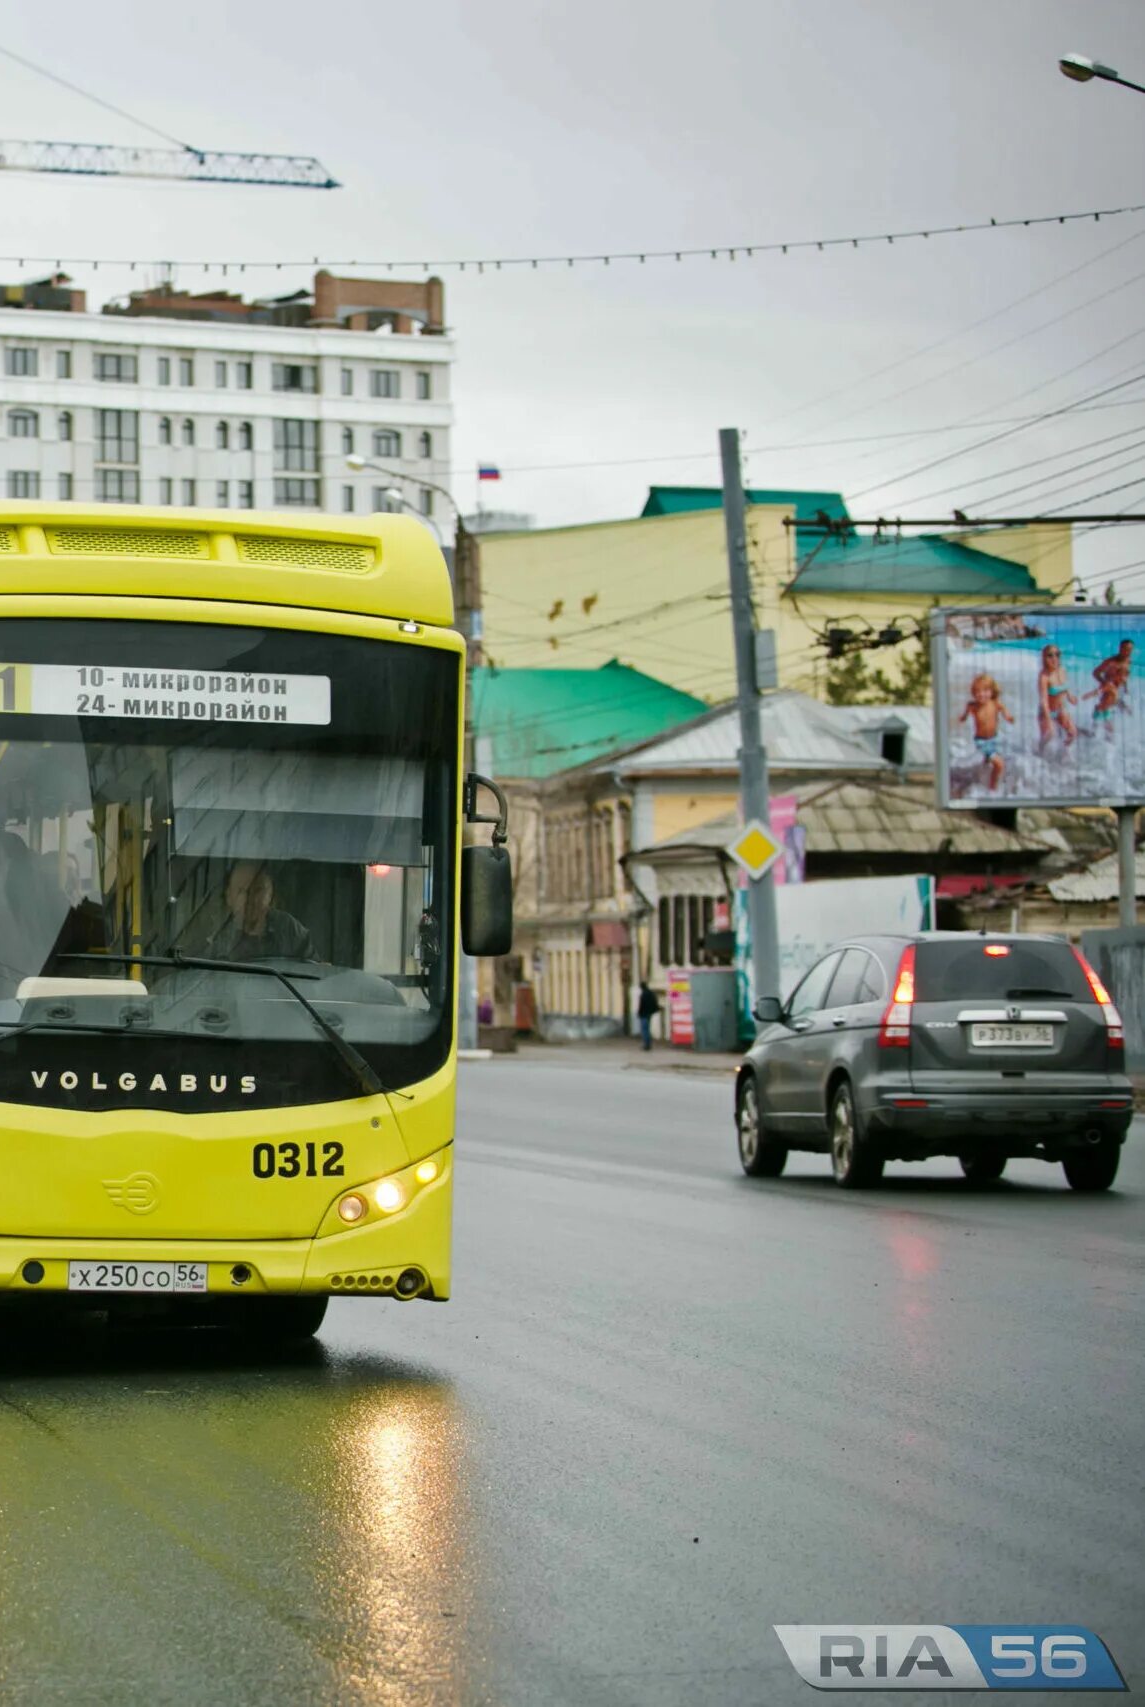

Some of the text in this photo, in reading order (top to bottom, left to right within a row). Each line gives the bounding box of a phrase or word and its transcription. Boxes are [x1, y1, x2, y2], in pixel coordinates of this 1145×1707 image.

[76, 667, 287, 695] 10- микрорайон
[77, 694, 287, 721] 24- микрорайон
[31, 1071, 257, 1094] VOLGABUS
[252, 1141, 345, 1179] 0312
[177, 1264, 199, 1281] 56
